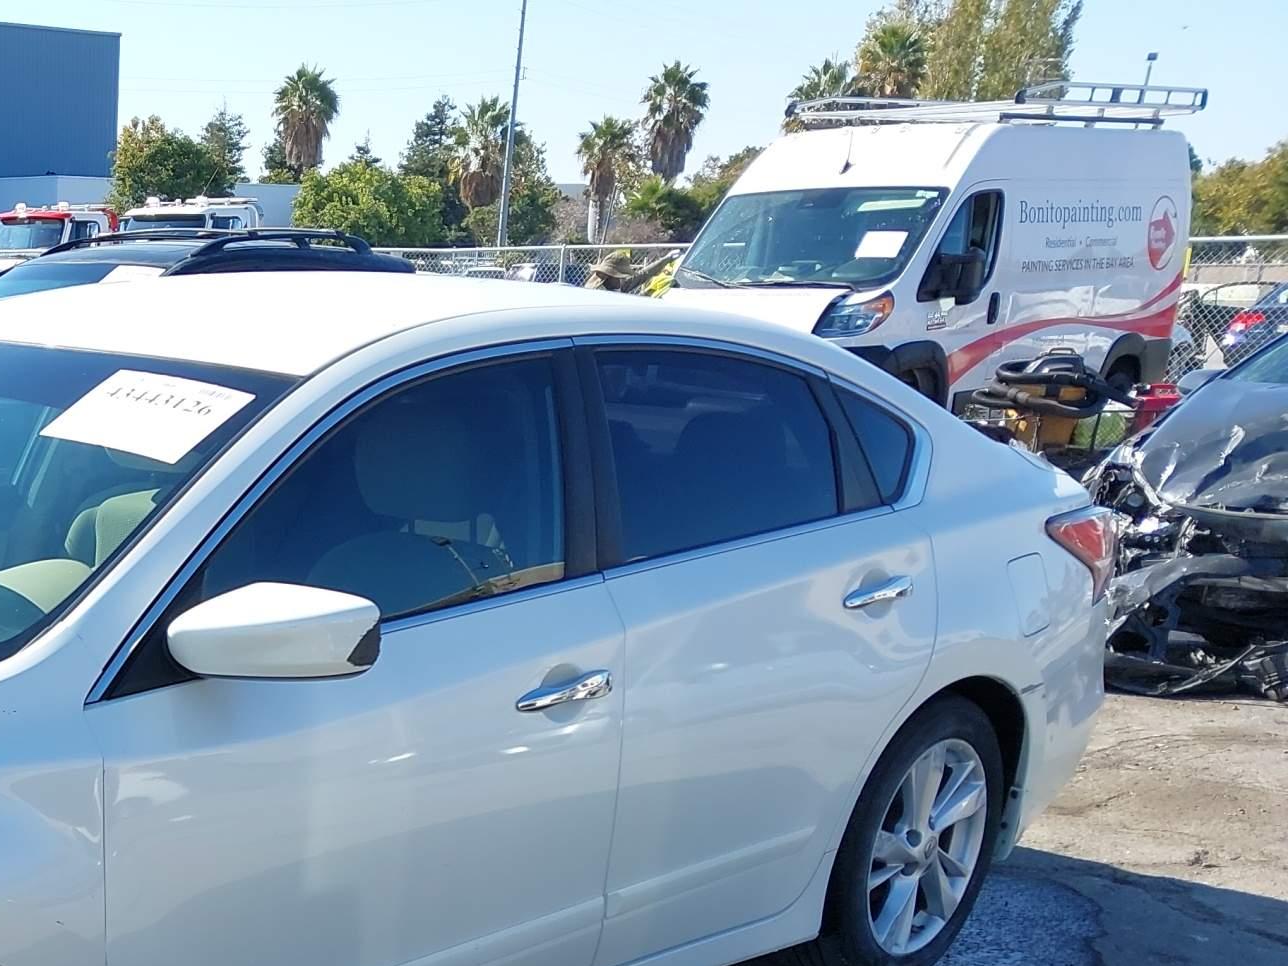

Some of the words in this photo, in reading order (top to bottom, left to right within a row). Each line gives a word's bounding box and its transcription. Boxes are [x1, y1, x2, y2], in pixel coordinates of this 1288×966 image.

[1019, 200, 1142, 229] Bonitopainting.com
[1022, 260, 1054, 272] PAINTING
[1054, 259, 1083, 272] SERVICES
[1084, 258, 1091, 270] IN
[1091, 258, 1105, 270] THE
